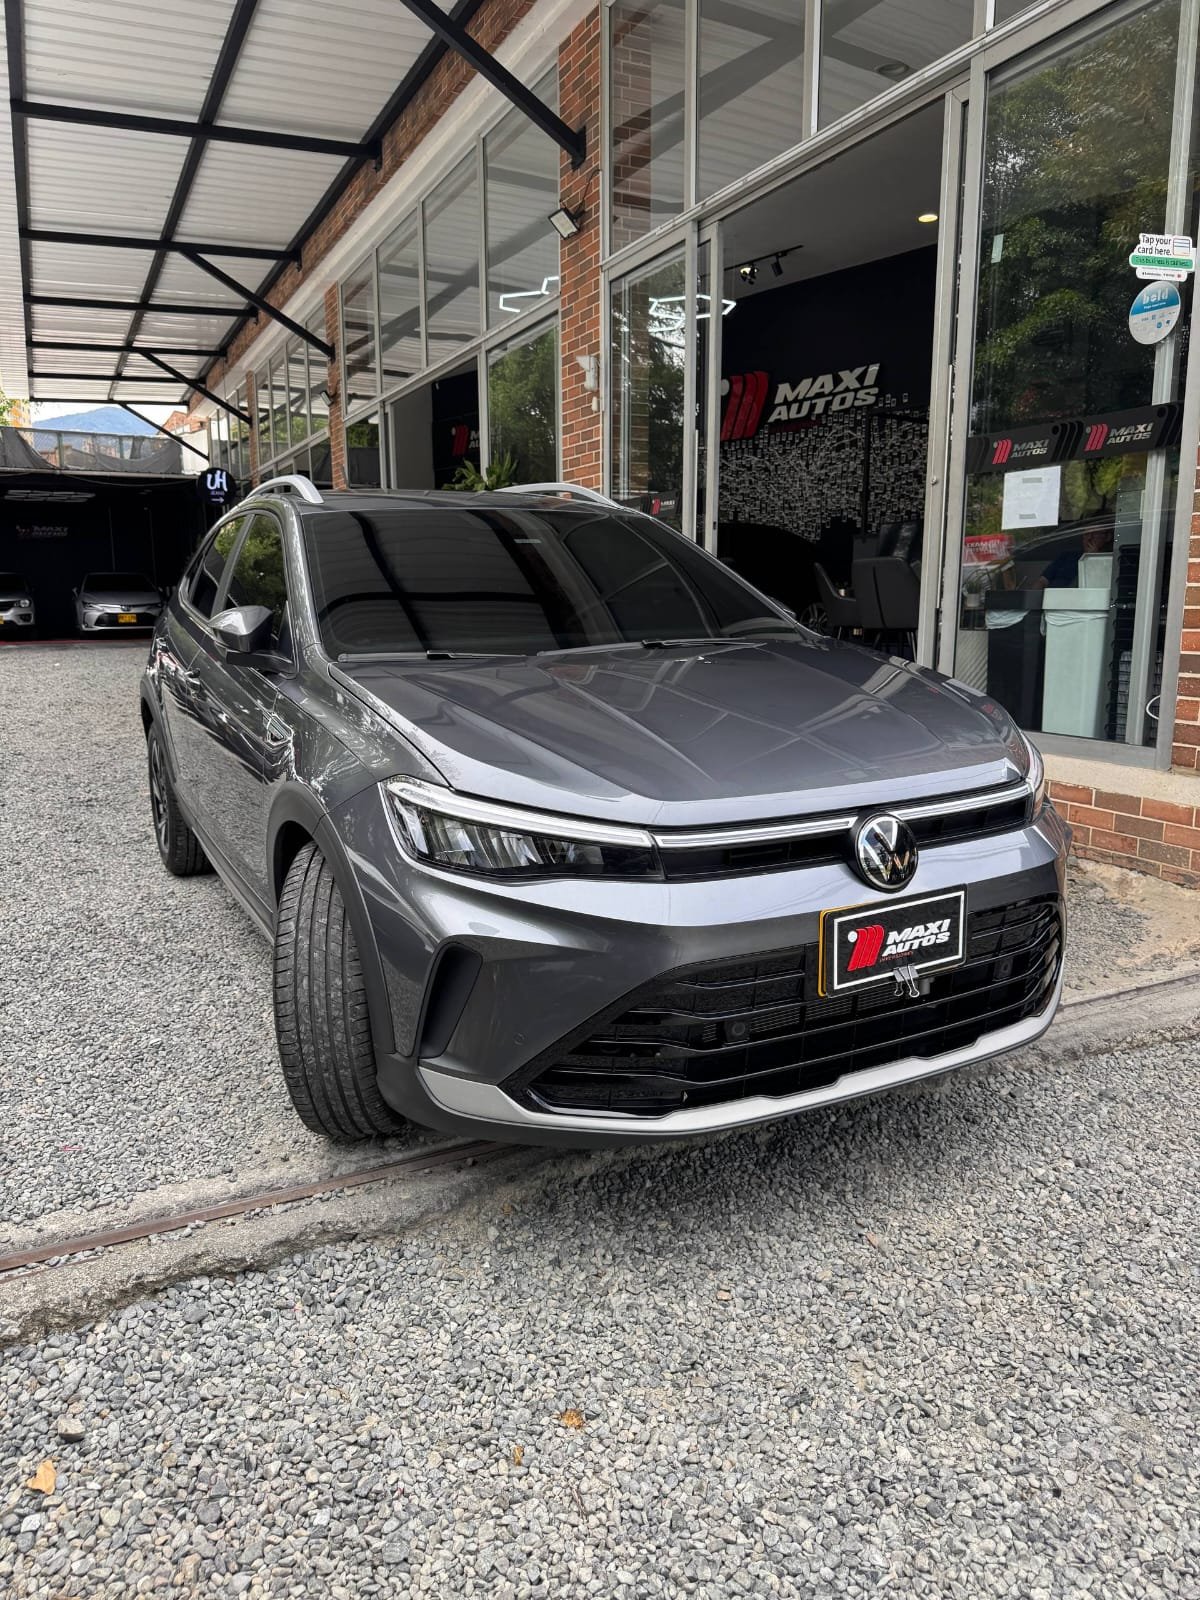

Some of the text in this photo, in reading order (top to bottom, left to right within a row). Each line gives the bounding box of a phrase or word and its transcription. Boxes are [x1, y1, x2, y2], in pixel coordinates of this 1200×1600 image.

[1142, 235, 1171, 247] Tap your
[1137, 246, 1172, 256] card here.
[774, 363, 881, 405] MAXI
[767, 387, 879, 423] AUTOS
[1110, 423, 1154, 437] MAXI
[1107, 432, 1151, 445] AUTOS
[1013, 440, 1048, 451] MAXI
[1011, 447, 1047, 459] AUTOS
[886, 919, 951, 945] MAXI
[882, 932, 950, 957] AUTOS
